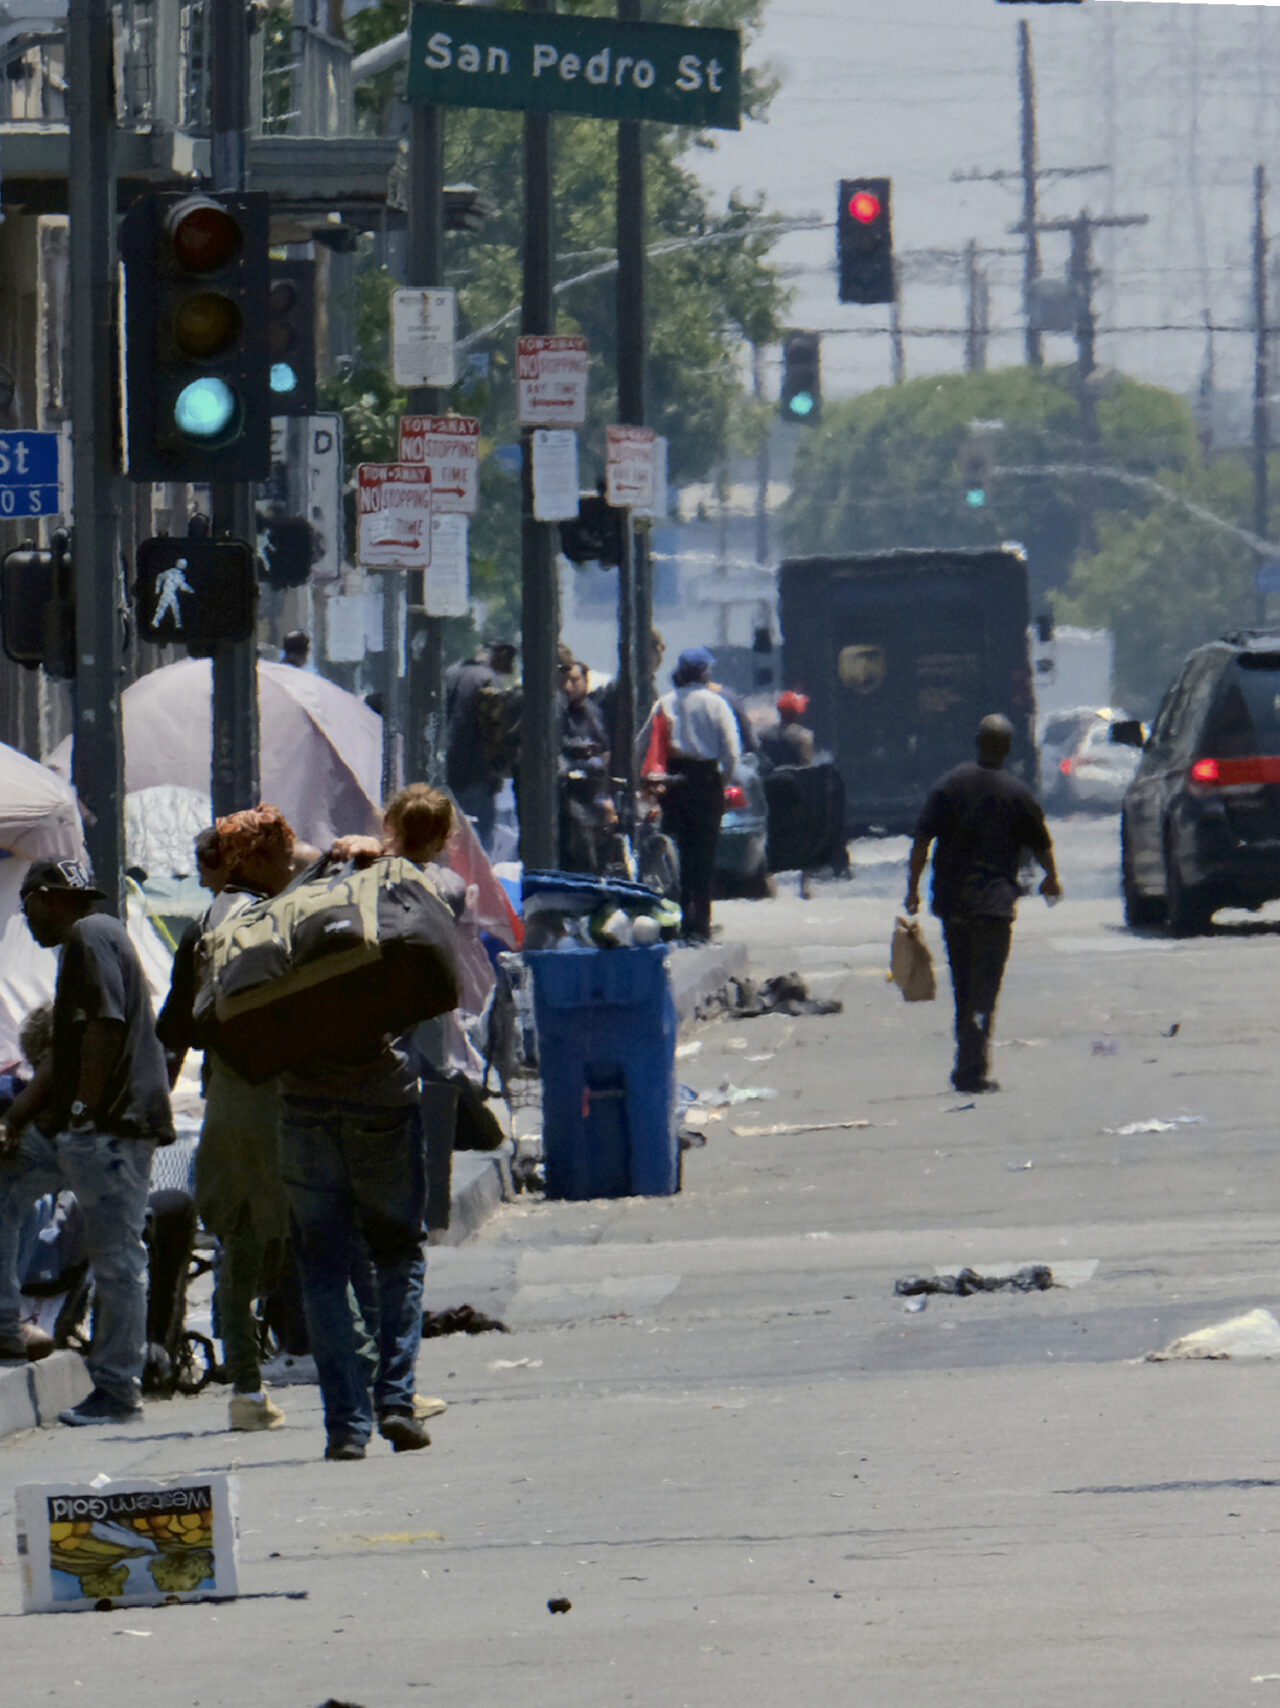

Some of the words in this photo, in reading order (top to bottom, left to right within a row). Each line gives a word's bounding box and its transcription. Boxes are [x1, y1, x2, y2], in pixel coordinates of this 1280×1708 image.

[425, 32, 510, 75] San
[532, 43, 656, 90] Pedro
[674, 53, 724, 93] St
[402, 437, 423, 461] NO
[29, 490, 42, 513] S
[361, 486, 380, 513] NO
[54, 1499, 108, 1520] Gold
[110, 1490, 210, 1512] Western
